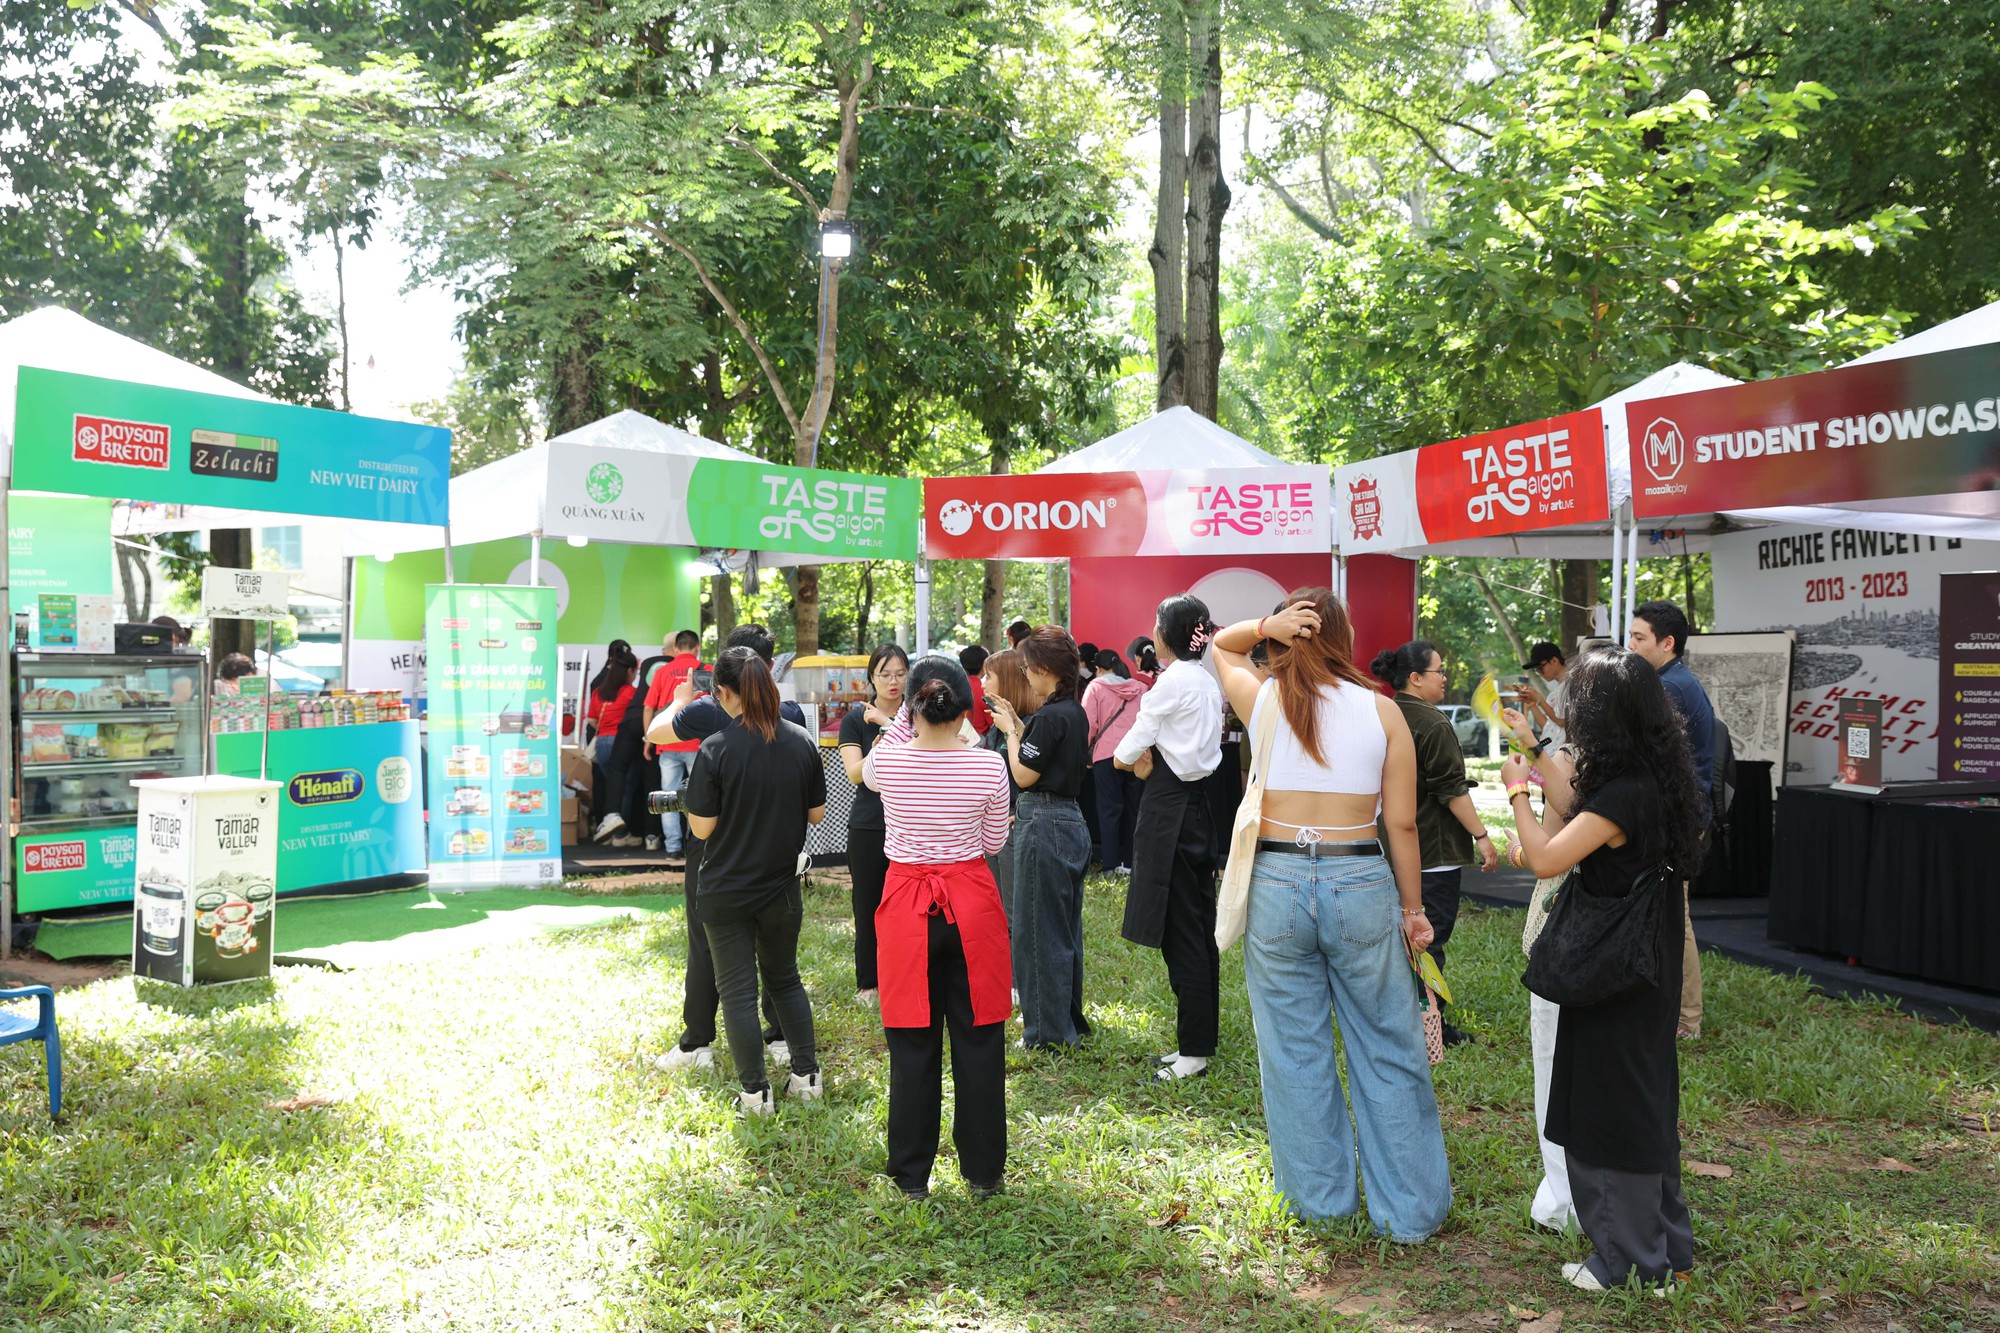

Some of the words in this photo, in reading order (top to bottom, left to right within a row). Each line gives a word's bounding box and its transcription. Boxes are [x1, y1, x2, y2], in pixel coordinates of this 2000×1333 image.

[1694, 421, 1819, 464] STUDENT
[1825, 397, 2000, 449] SHOWCAS
[359, 460, 408, 474] DISTRIBUTED
[409, 466, 420, 475] BY
[1462, 429, 1572, 484] TASTE
[310, 470, 343, 487] NEW
[346, 473, 376, 490] VIET
[378, 477, 419, 495] DAIRY
[762, 474, 887, 515] TASTE
[1188, 483, 1313, 510] TASTE
[1539, 501, 1549, 514] by
[8, 527, 36, 538] AIRY
[845, 536, 857, 547] by
[1274, 528, 1285, 537] by
[1759, 532, 1825, 570] RICHIE
[1831, 528, 1962, 561] FAWCE
[1805, 577, 1844, 603] 2013
[1862, 571, 1909, 598] 2023
[564, 662, 591, 671] SIDE
[295, 774, 356, 798] Hénaff
[281, 839, 308, 852] NEW
[310, 834, 338, 848] VIET
[340, 829, 373, 844] DAIRY
[79, 889, 101, 900] NEW
